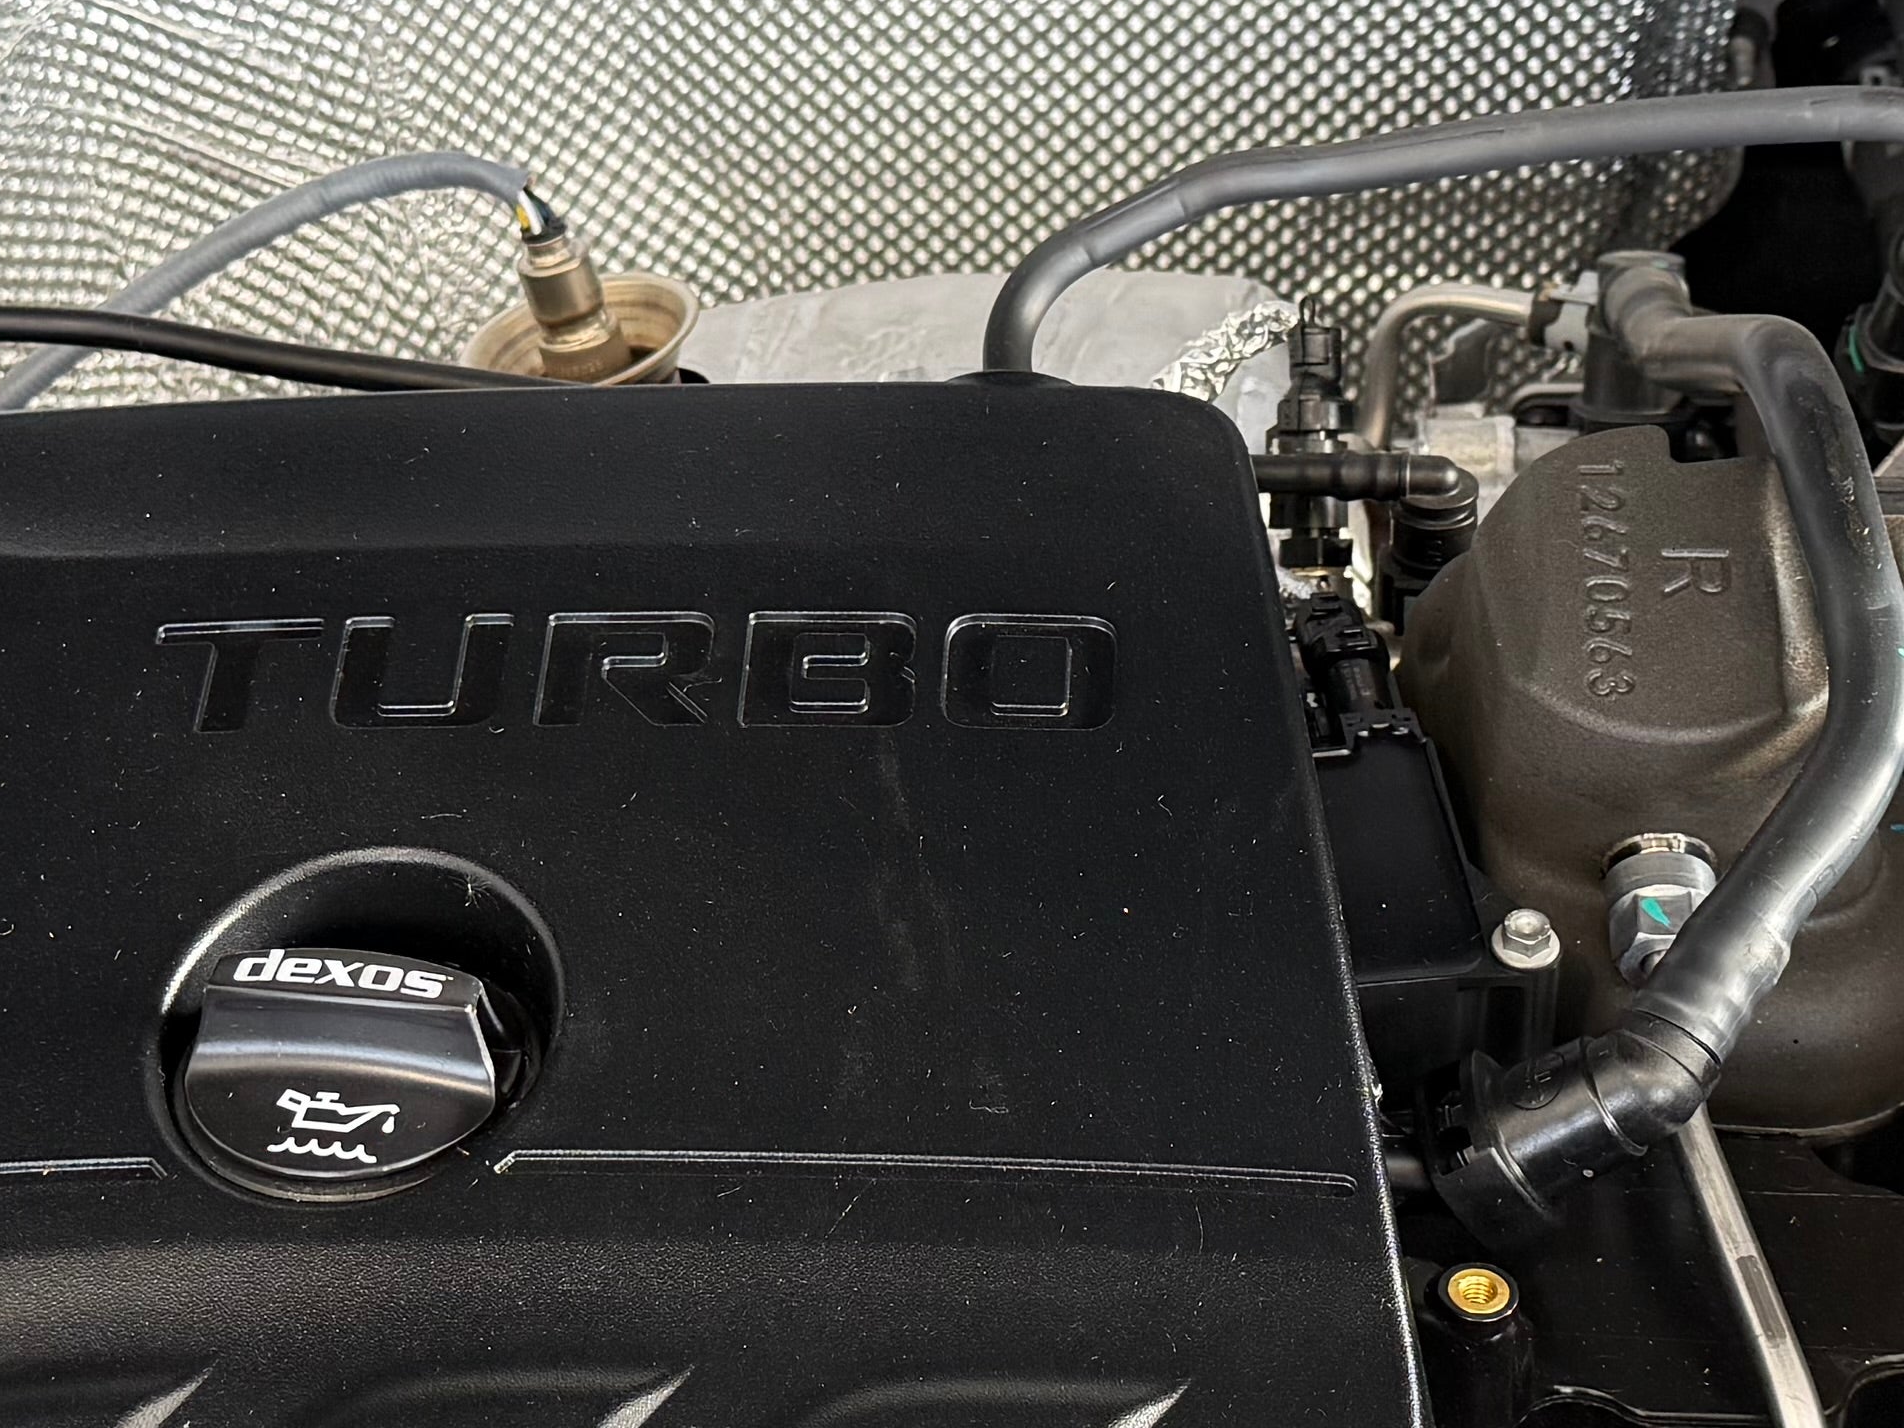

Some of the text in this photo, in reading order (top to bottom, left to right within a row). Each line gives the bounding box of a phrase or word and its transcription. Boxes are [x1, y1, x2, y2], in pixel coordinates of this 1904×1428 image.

[1578, 459, 1636, 699] 12670563
[1661, 546, 1733, 598] R
[154, 607, 1120, 733] TURBO
[232, 948, 445, 999] dexos
